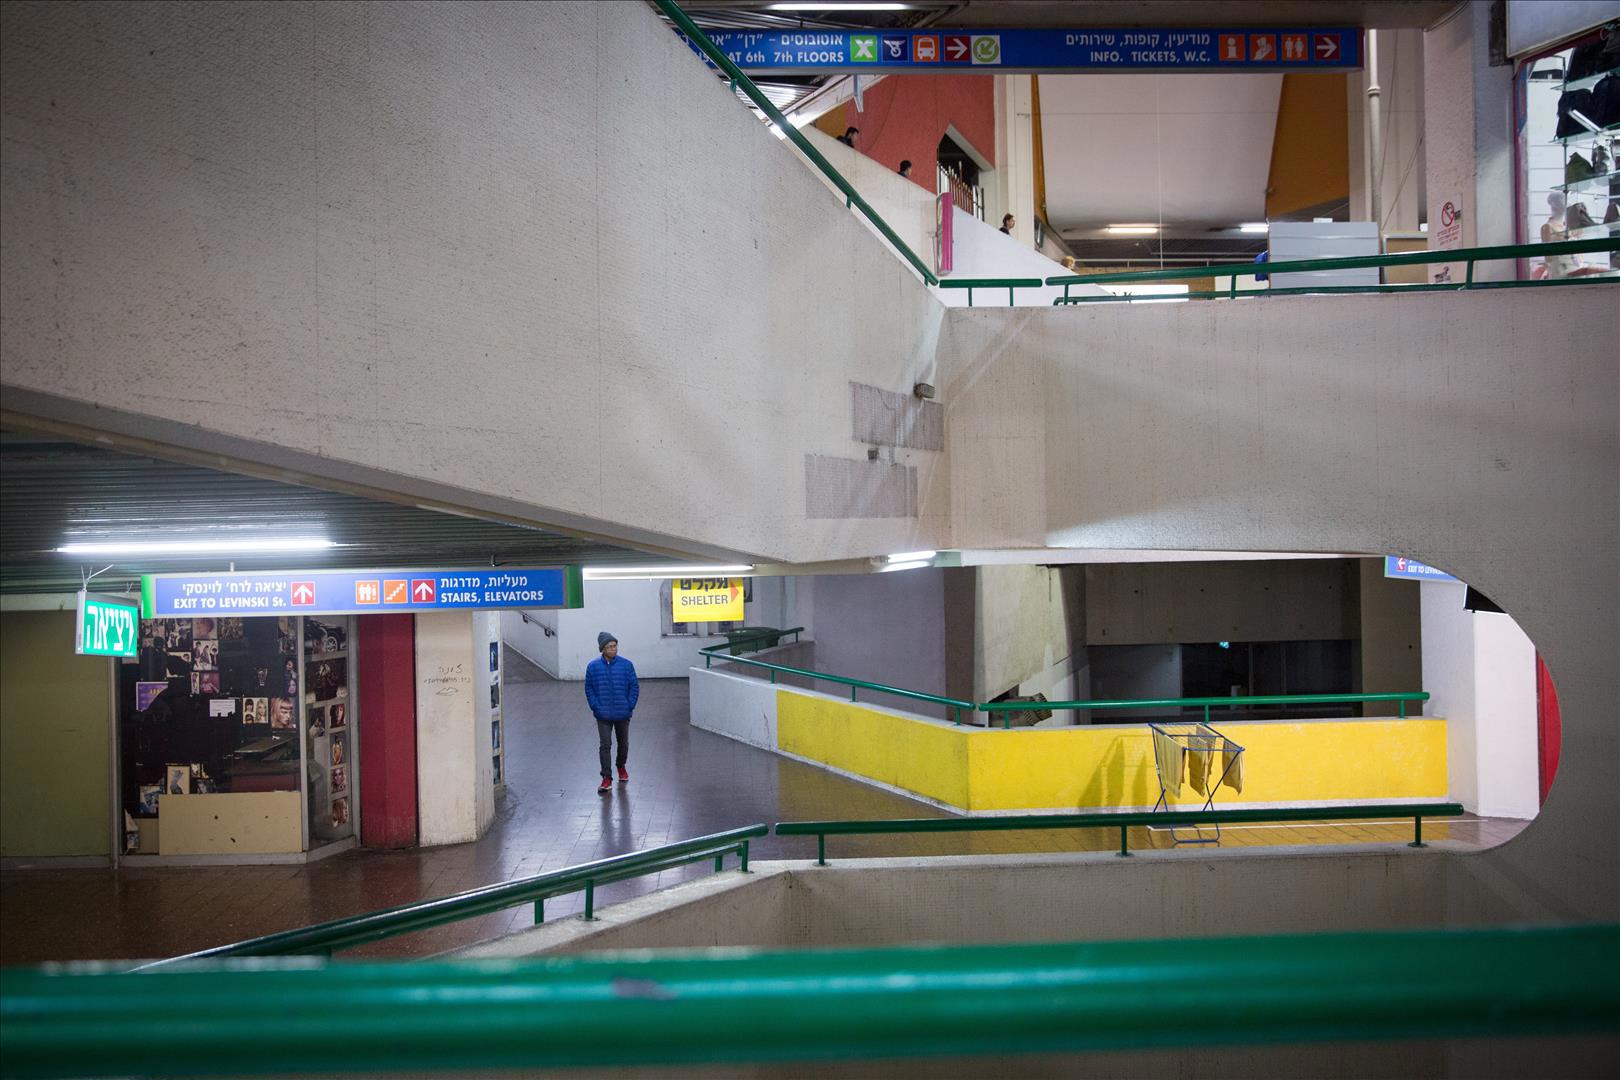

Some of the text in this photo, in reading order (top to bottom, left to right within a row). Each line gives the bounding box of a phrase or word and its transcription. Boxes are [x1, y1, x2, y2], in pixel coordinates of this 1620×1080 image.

[781, 34, 843, 46] אוטובוסים
[1066, 34, 1210, 47] מודיעין, קופות, שירותים
[728, 51, 844, 63] AT 6th 7th FLOORS
[1090, 51, 1210, 63] INFO. TICKETS, W.C.
[182, 580, 222, 596] לוינסקי
[255, 581, 286, 593] יציאה
[440, 575, 528, 588] מעליות, מדרגות
[173, 596, 287, 609] EXIT TO LEVINSKI St.
[440, 590, 544, 603] STAIRS, ELEVATORS
[681, 594, 728, 606] SHELTER
[86, 605, 130, 651] יציאה
